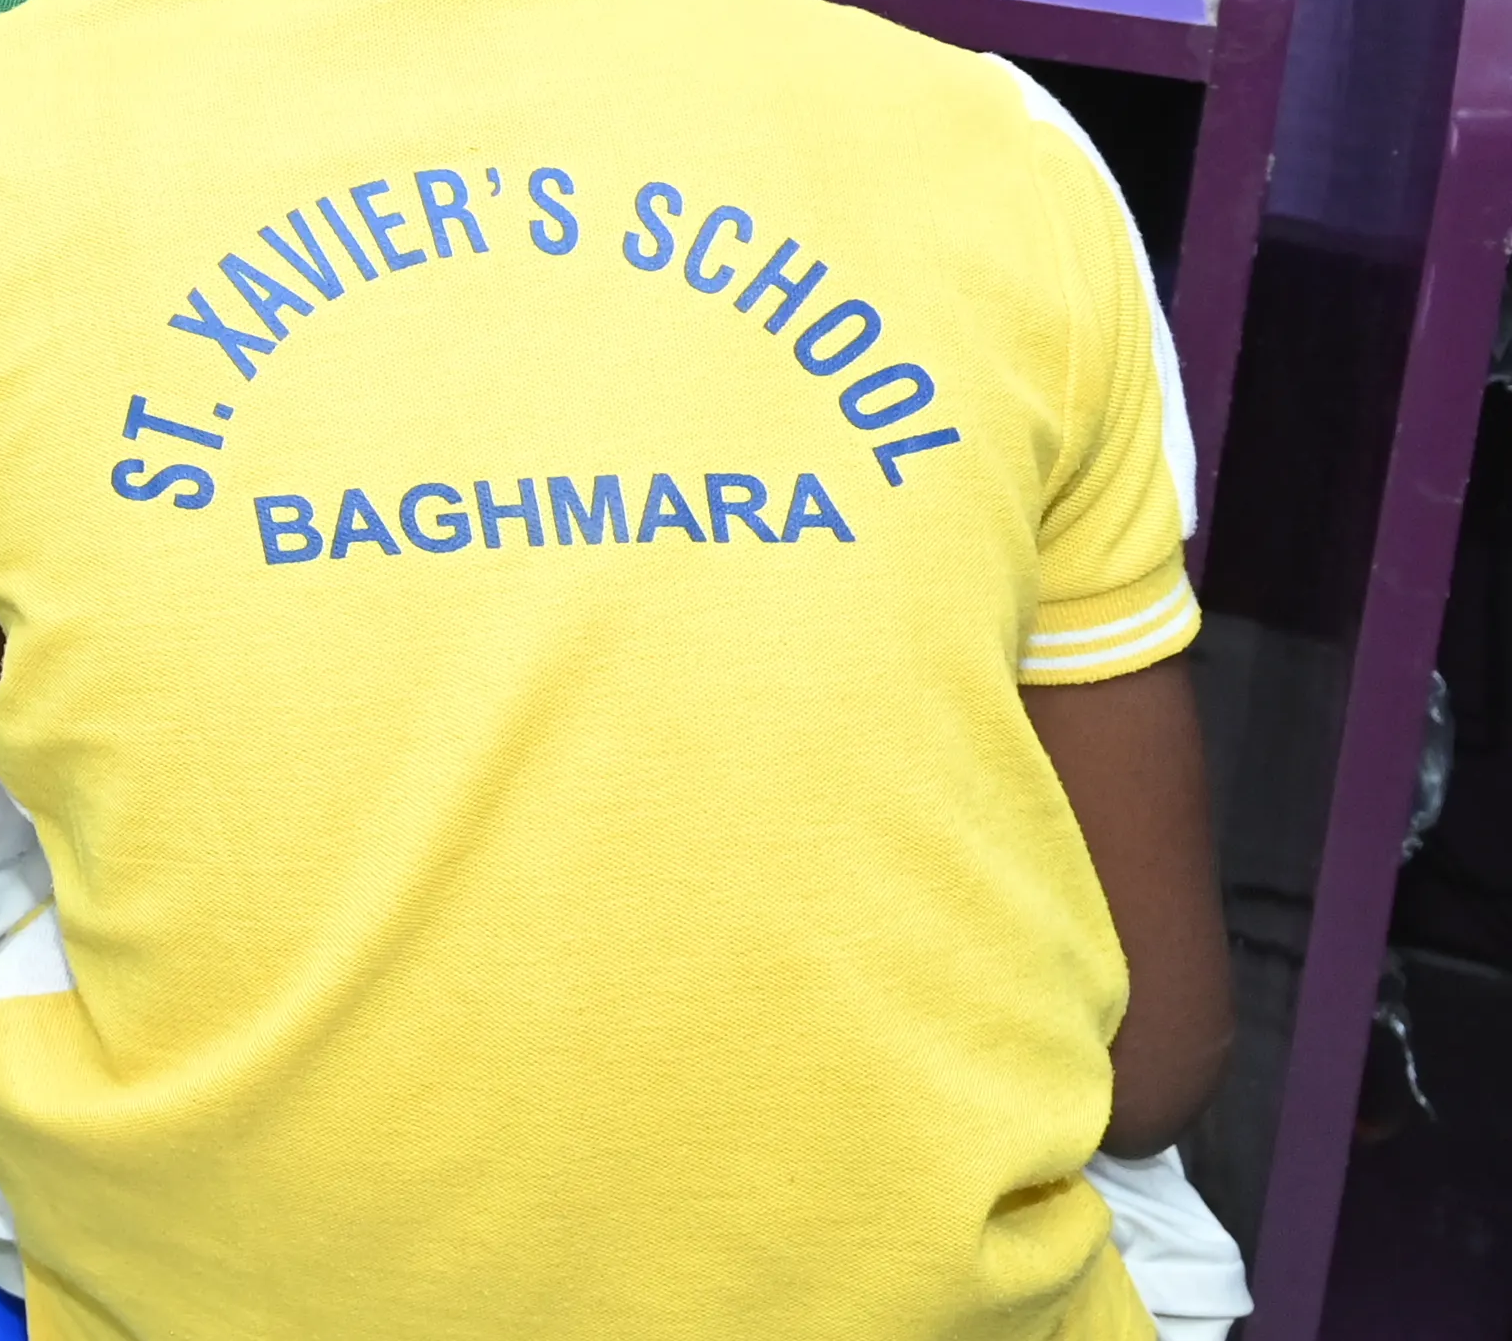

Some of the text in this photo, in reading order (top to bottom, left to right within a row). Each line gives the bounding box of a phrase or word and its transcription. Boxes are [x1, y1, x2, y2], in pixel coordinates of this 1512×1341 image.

[110, 166, 962, 511] ST. XAVIER'S SCHOOL
[253, 472, 857, 566] BAGHMARA
